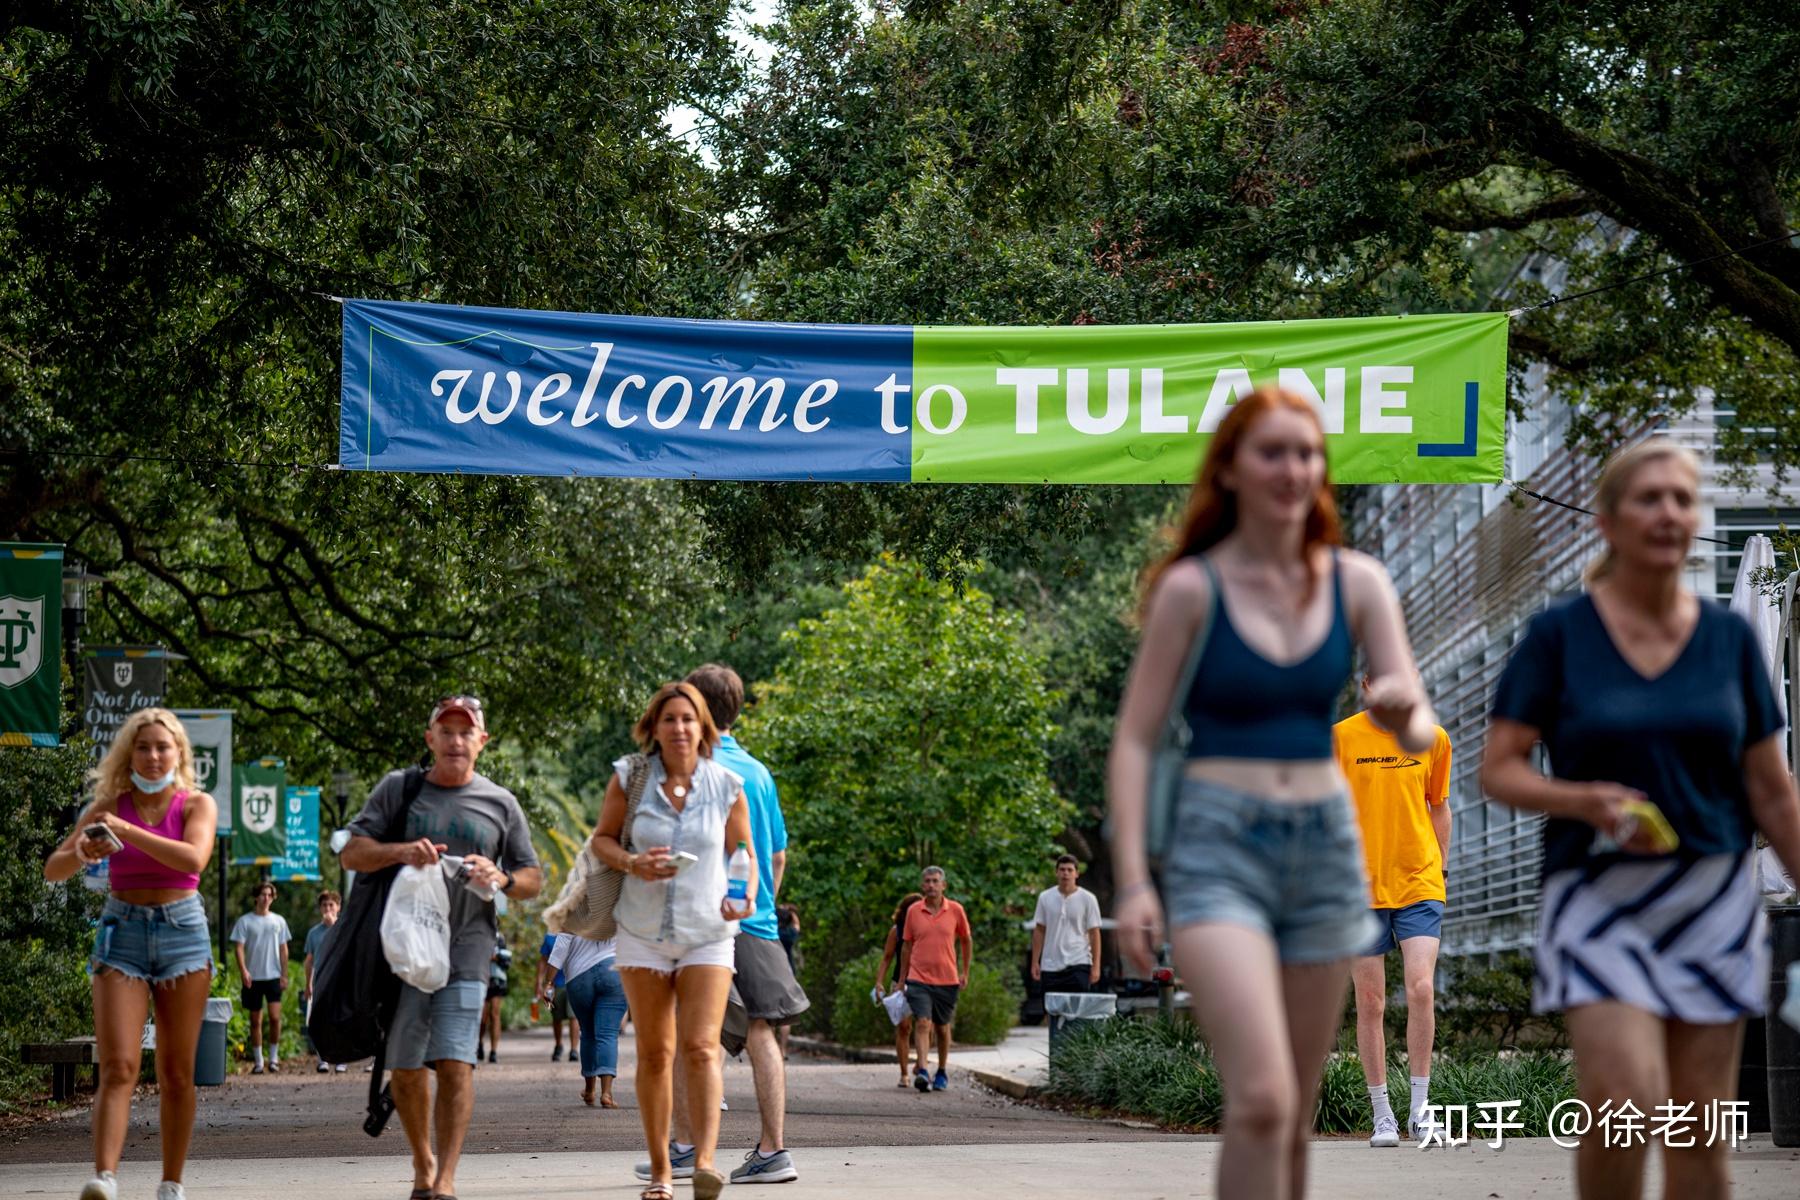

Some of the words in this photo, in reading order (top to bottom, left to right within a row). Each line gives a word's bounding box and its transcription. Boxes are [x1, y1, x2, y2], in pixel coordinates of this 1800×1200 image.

[431, 342, 839, 433] welcome
[873, 373, 968, 435] to
[996, 366, 1414, 434] TULANE
[90, 691, 125, 707] Not
[125, 690, 161, 712] for
[1356, 756, 1398, 765] EMPACHER
